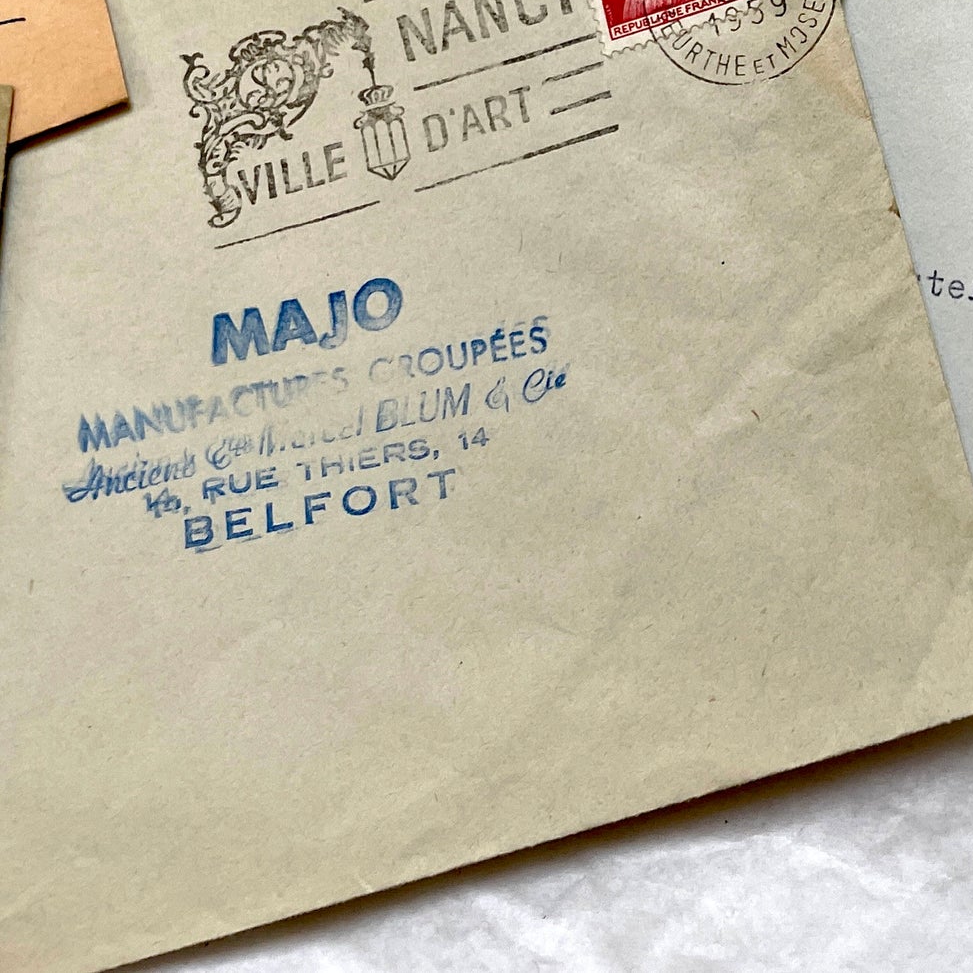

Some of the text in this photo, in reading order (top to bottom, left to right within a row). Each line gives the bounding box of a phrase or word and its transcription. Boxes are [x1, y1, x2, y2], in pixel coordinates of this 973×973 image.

[613, 7, 685, 37] REPUBLIQUE
[753, 53, 776, 75] ET
[237, 85, 532, 206] VILLE D'ART
[210, 277, 404, 367] MAJO
[375, 380, 472, 434] BLUM
[202, 466, 280, 504] RUE
[298, 436, 442, 481] THIERS,
[457, 427, 491, 451] 14
[183, 467, 458, 551] BELFORT
